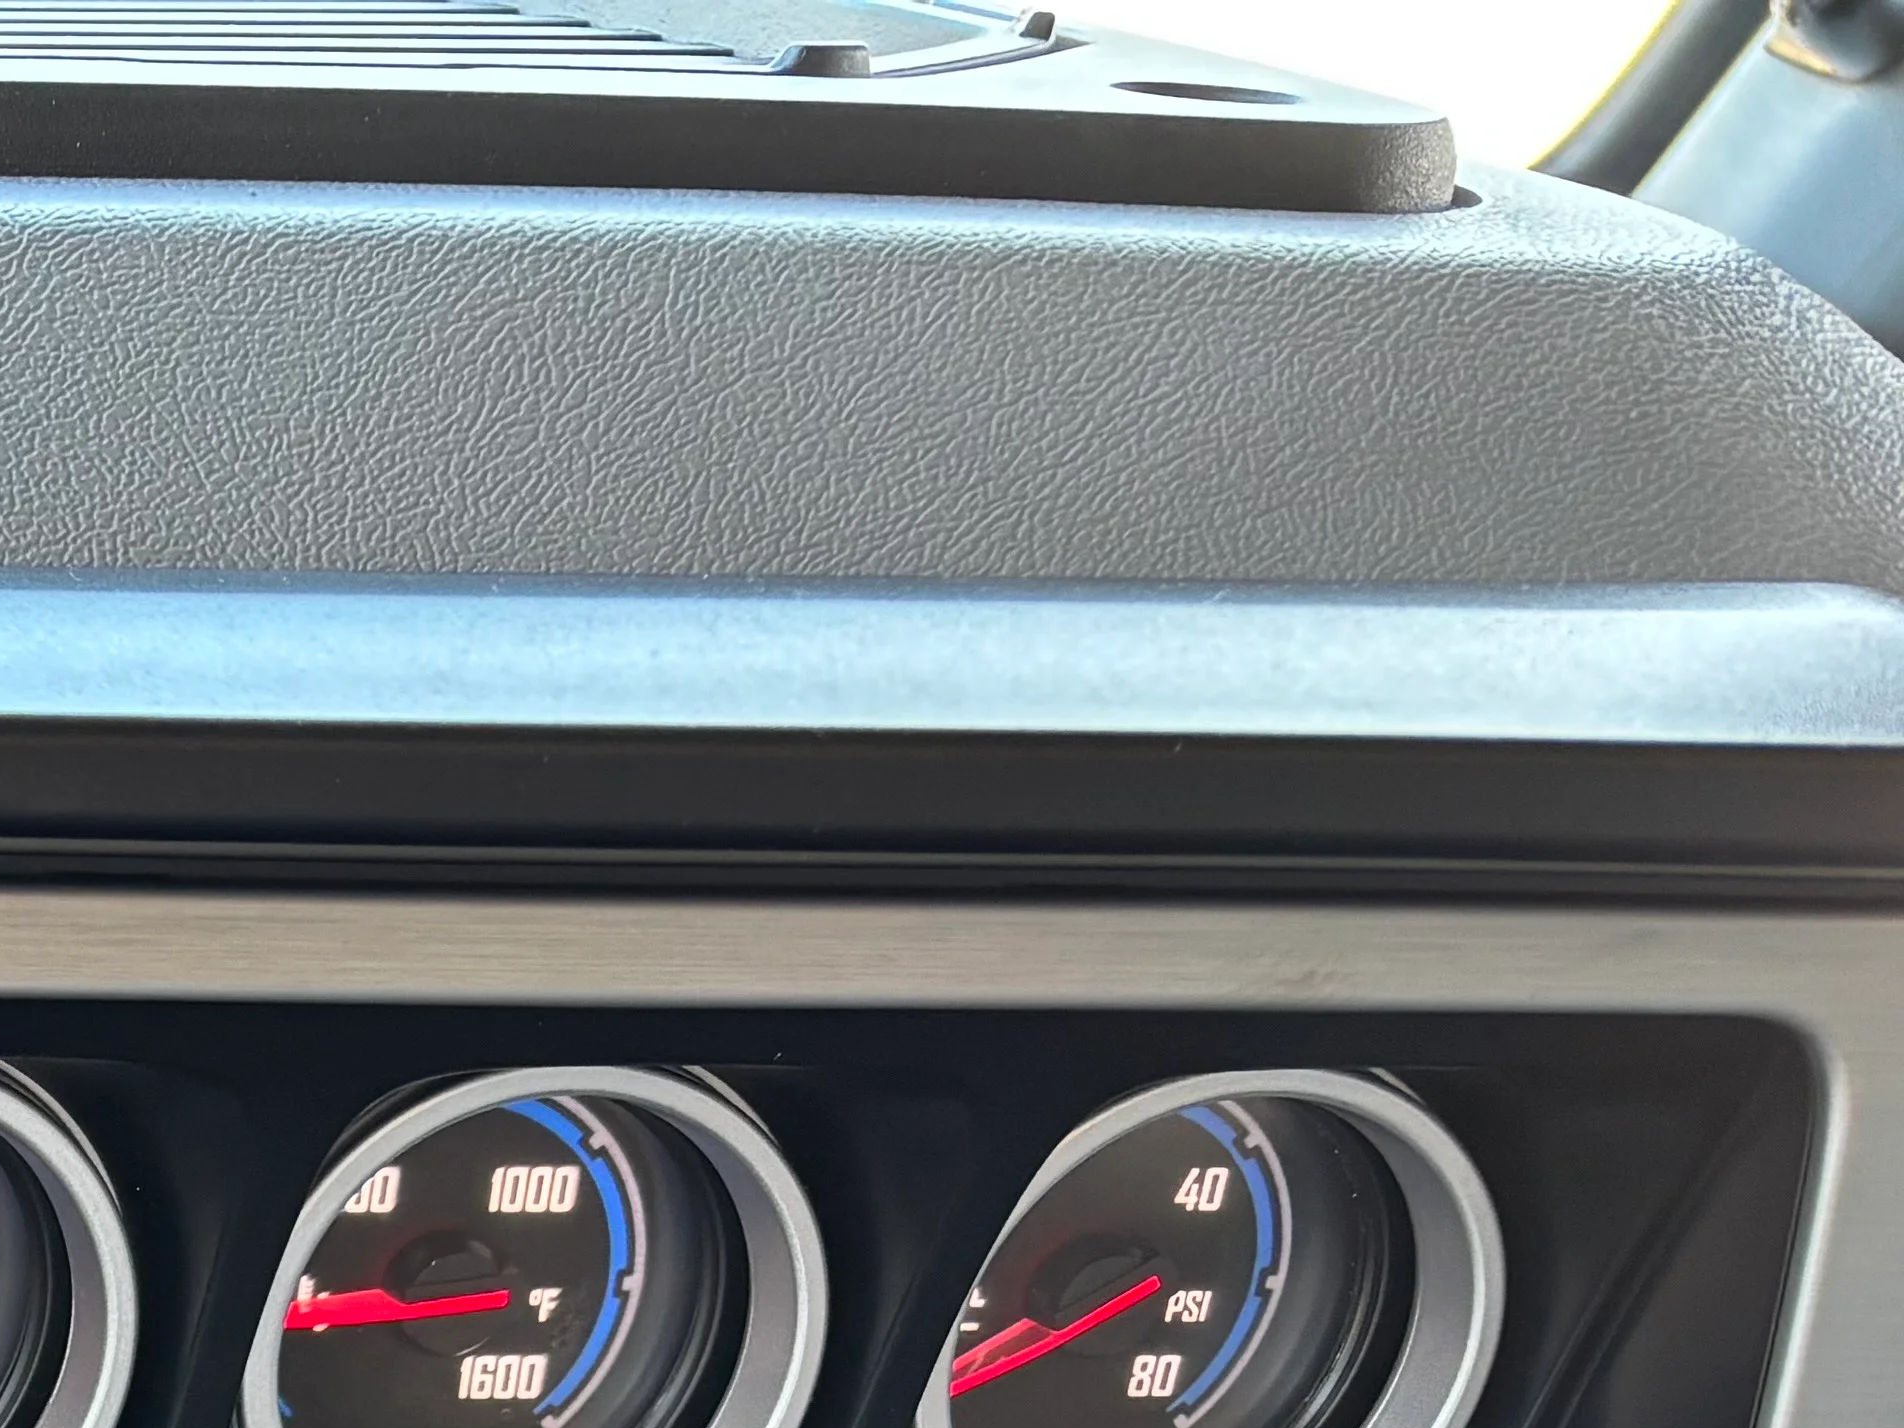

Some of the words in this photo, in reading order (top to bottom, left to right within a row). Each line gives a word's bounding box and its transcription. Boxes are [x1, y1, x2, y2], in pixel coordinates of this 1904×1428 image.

[488, 1165, 580, 1213] 1000
[1173, 1166, 1230, 1212] 40
[1164, 1289, 1213, 1323] PSI
[458, 1354, 548, 1400] 1600
[1127, 1354, 1182, 1398] 80
